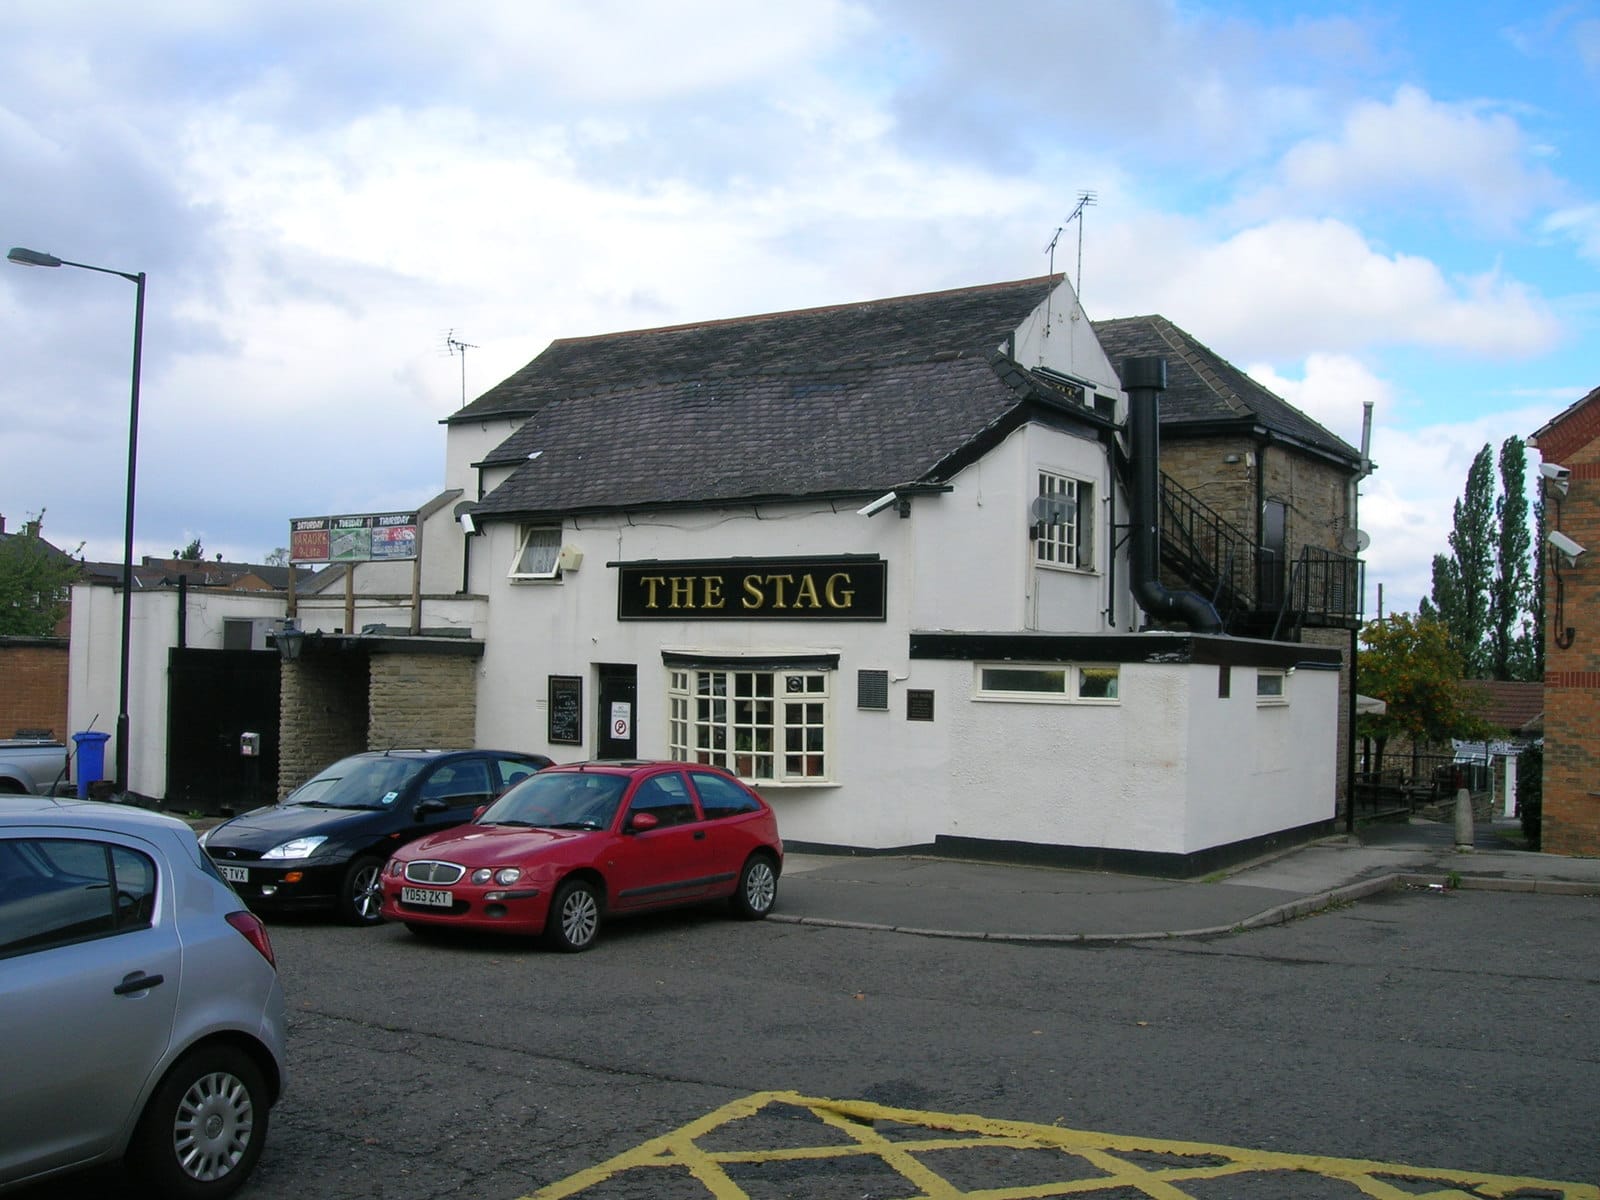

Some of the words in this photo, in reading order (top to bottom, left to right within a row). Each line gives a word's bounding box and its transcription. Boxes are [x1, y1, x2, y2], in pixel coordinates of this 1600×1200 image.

[379, 515, 410, 525] THURSDAY
[640, 576, 725, 609] THE
[742, 572, 855, 609] STAG
[230, 868, 245, 881] TVX
[429, 890, 448, 904] ZKT
